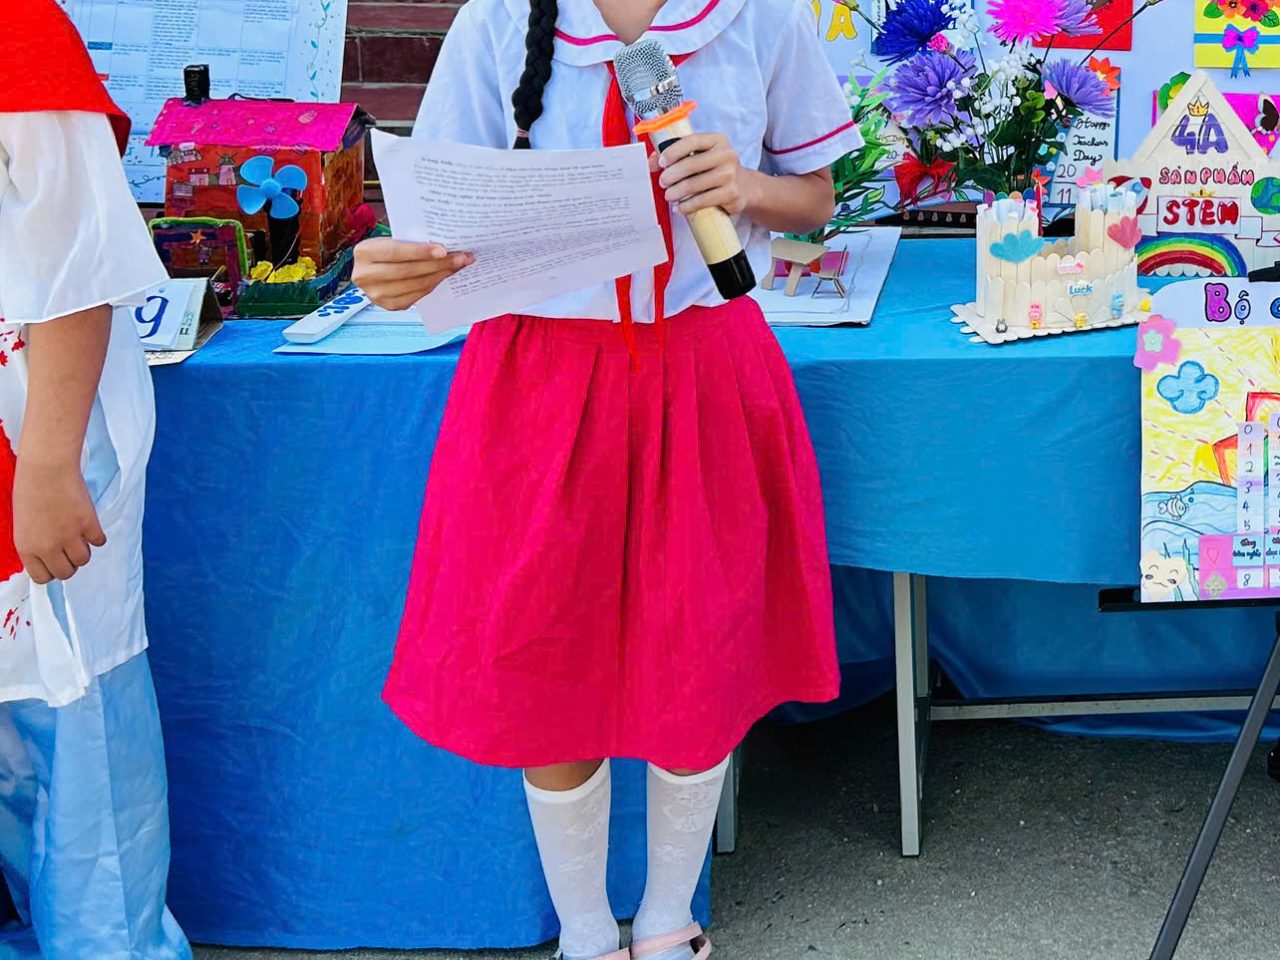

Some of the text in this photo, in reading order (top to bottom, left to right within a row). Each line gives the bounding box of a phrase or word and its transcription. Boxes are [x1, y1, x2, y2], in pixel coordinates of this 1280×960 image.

[1171, 113, 1229, 155] 4A
[1073, 149, 1102, 166] Day
[1056, 163, 1077, 178] 20
[1057, 188, 1072, 204] 11
[1162, 199, 1239, 226] STEM
[1069, 285, 1094, 295] Luck
[1204, 282, 1251, 324] Bộ
